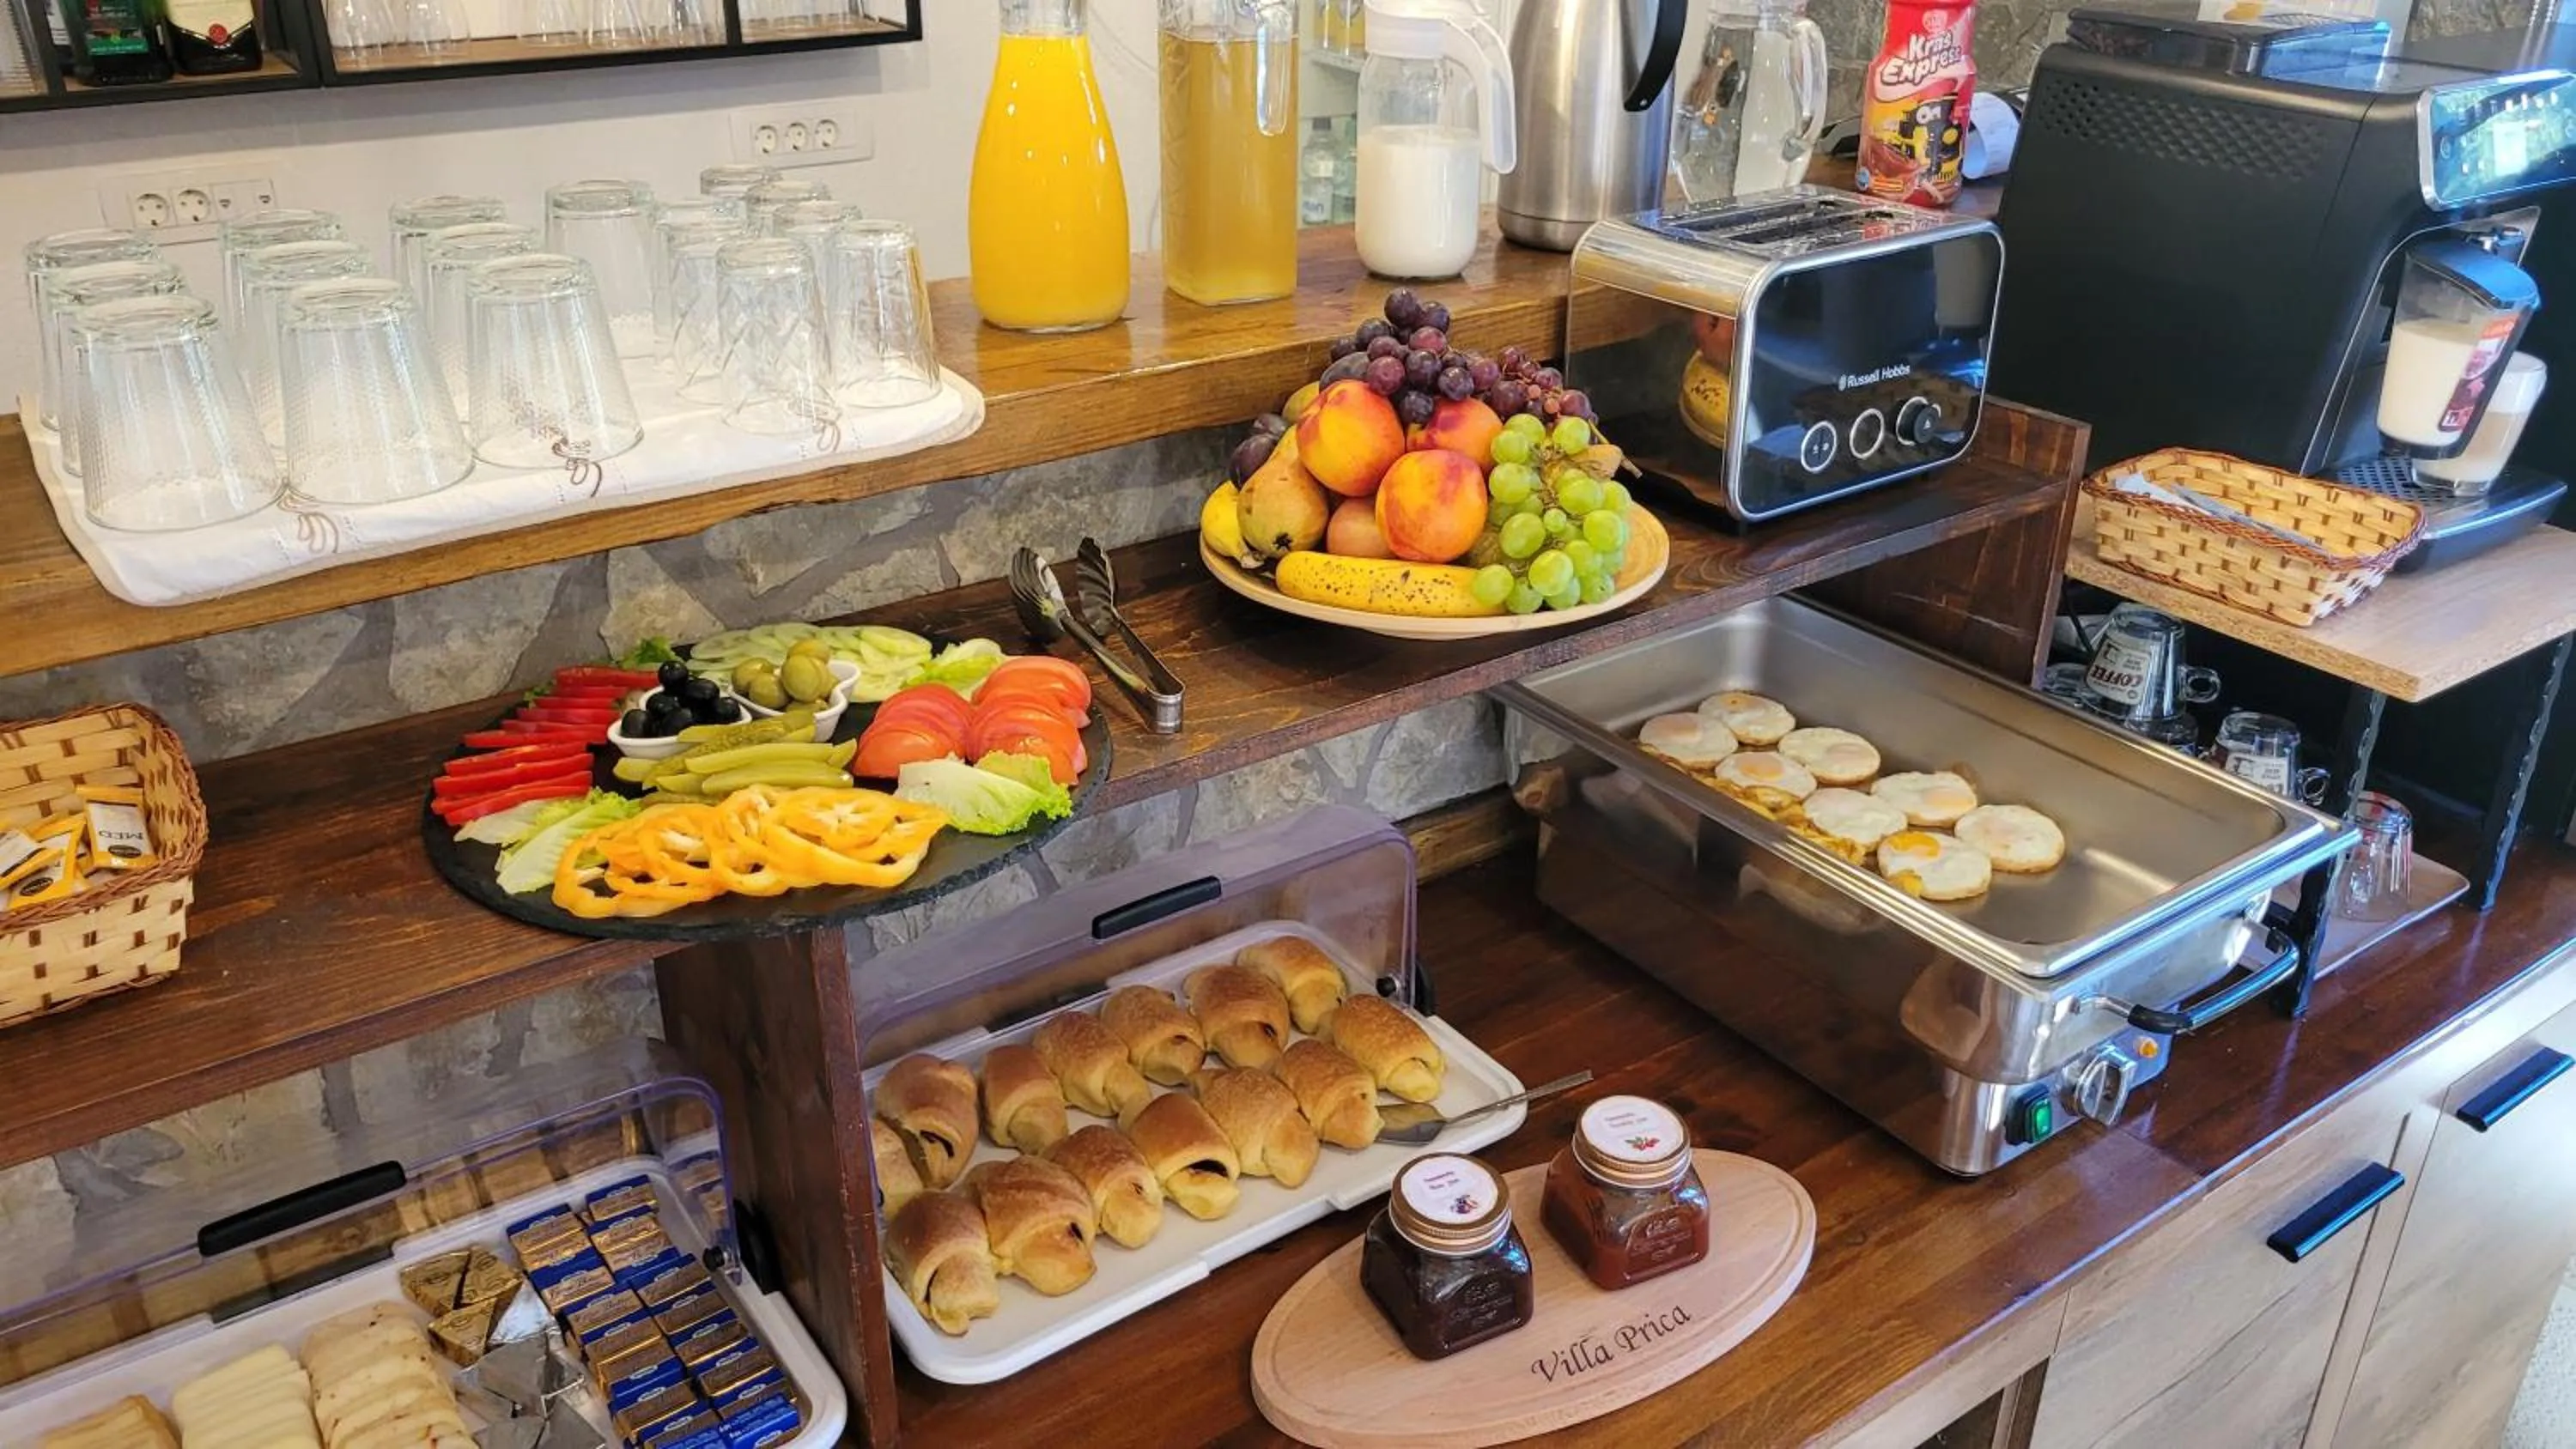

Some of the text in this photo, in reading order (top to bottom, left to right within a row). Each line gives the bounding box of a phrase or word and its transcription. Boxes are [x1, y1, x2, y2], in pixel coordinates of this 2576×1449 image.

[1880, 45, 1962, 86] Express
[1847, 363, 1911, 389] Russell Hobbs
[99, 830, 143, 840] MED
[1531, 1305, 1692, 1383] Villa Prica
